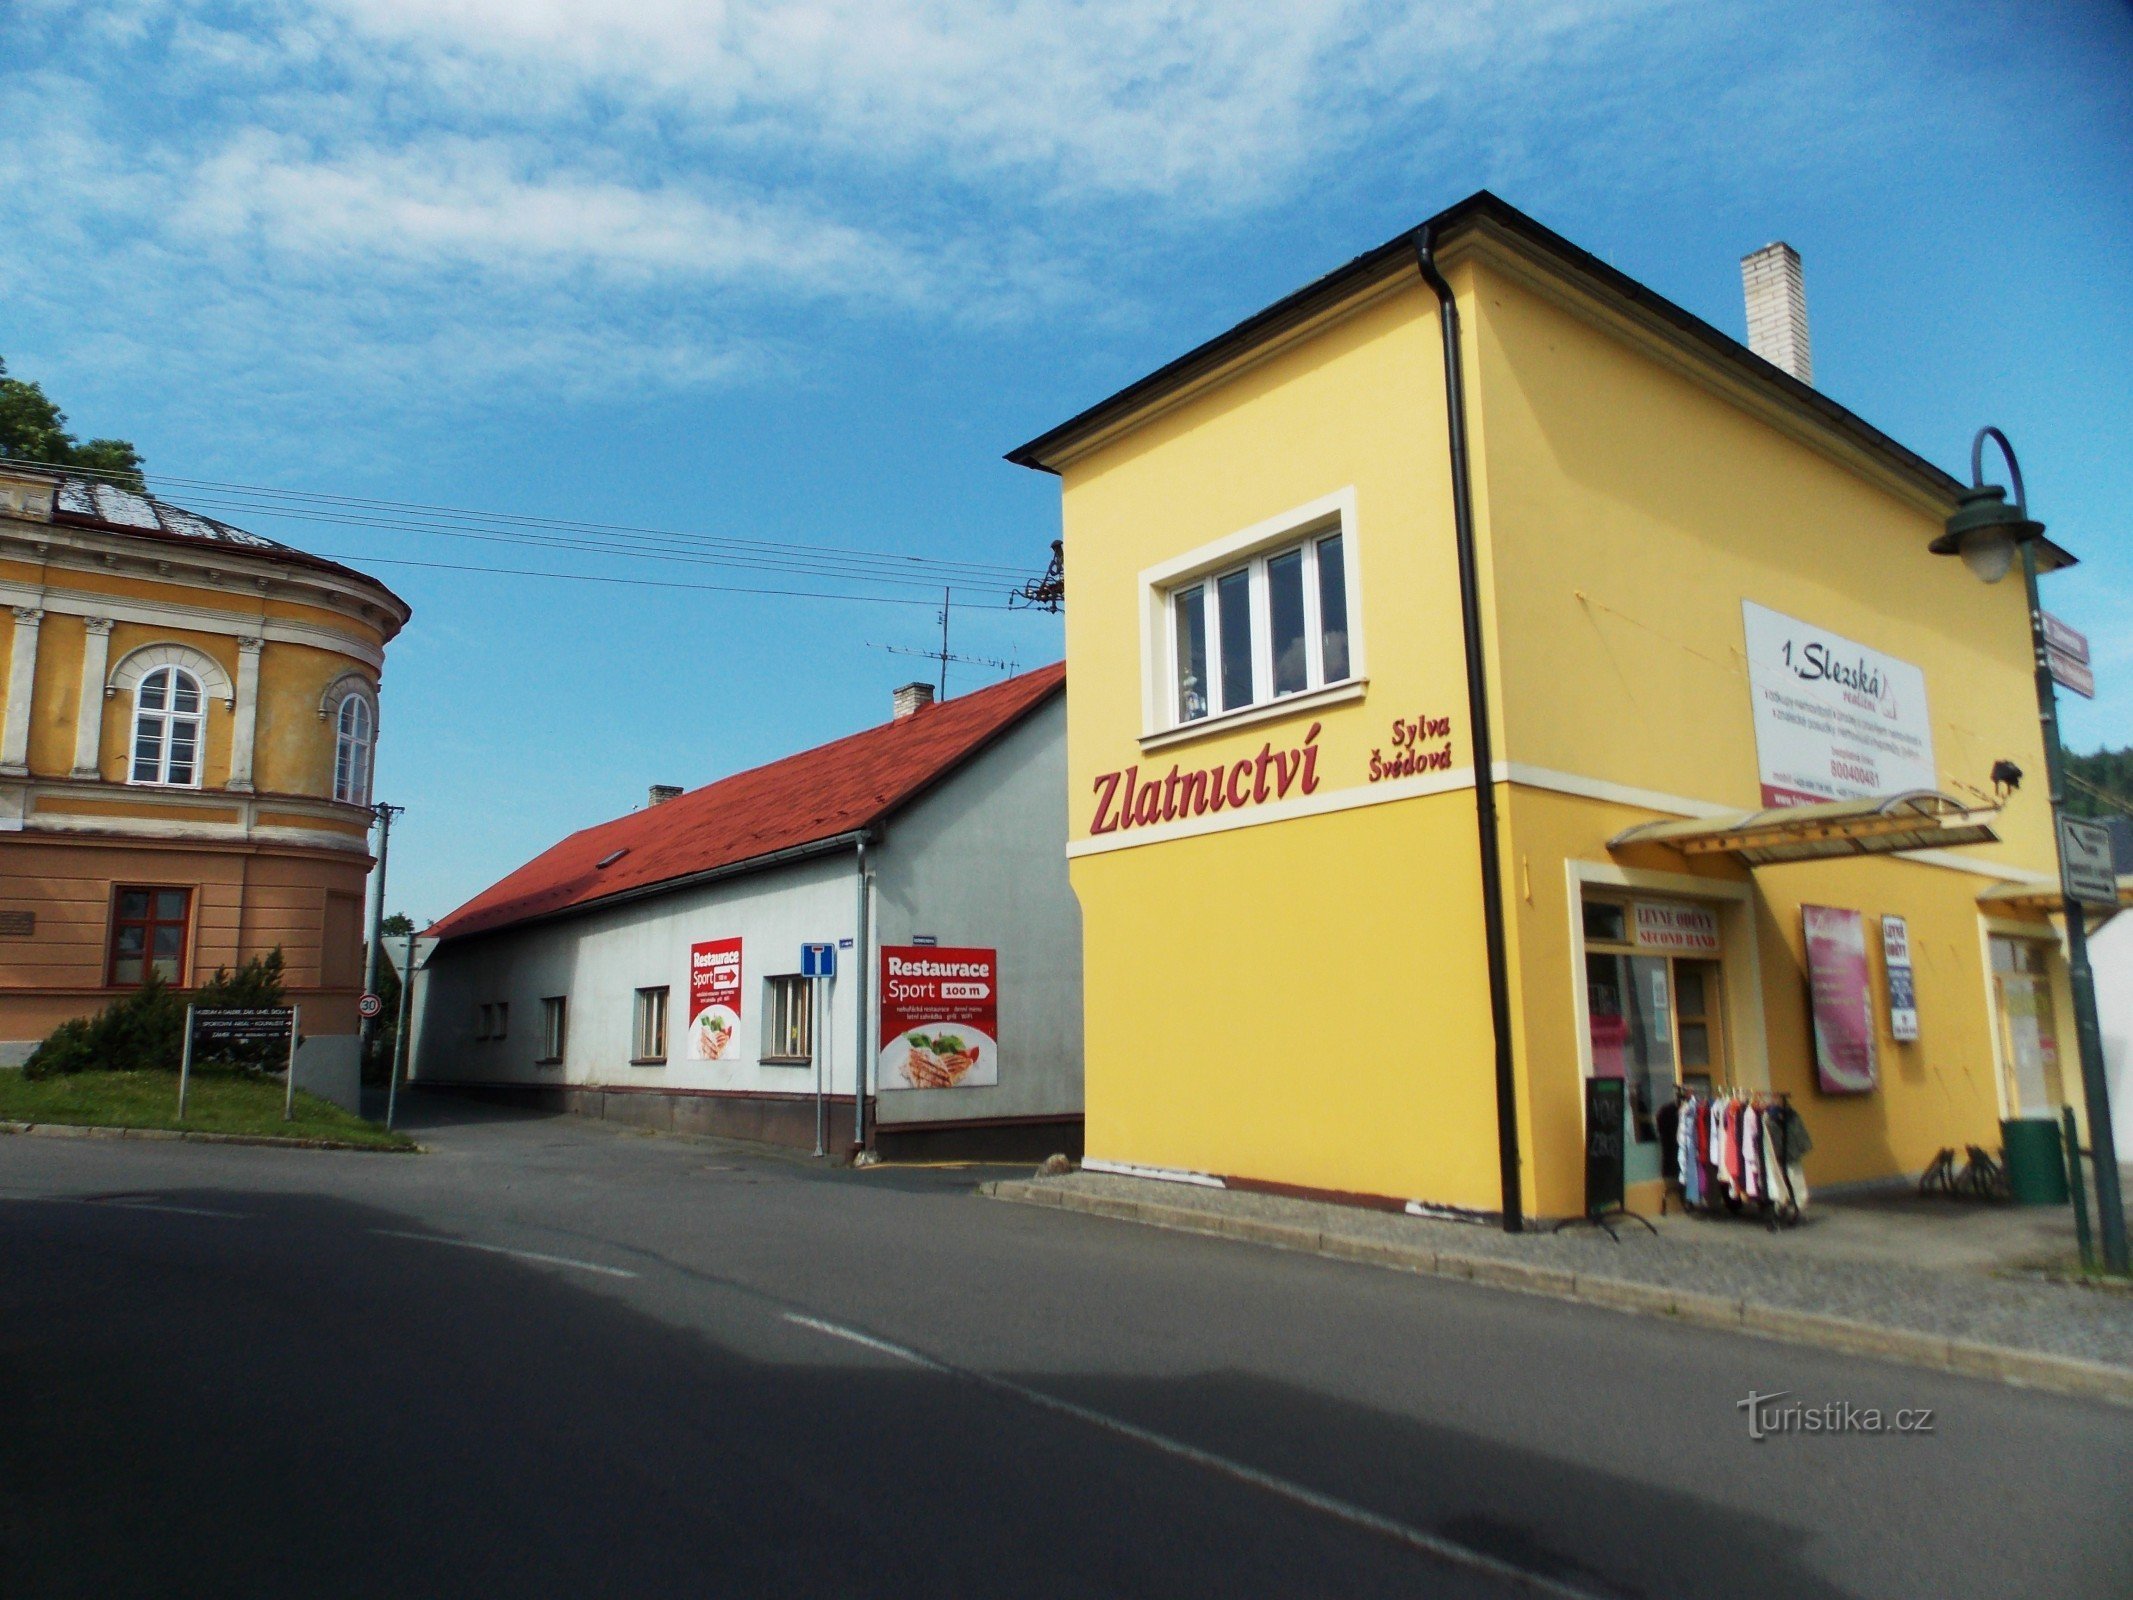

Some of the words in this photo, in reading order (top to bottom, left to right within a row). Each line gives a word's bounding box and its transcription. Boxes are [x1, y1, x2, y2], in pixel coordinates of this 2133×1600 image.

[1392, 714, 1450, 749] Sylva
[1369, 742, 1452, 782] Švédová
[1090, 722, 1321, 835] Zlatnictví
[693, 950, 739, 968] Restaurace
[888, 957, 989, 977] Restaurace
[693, 970, 713, 988] Sport
[889, 980, 935, 1001] Sport
[946, 987, 966, 995] 100
[969, 987, 980, 995] m
[362, 1000, 376, 1010] 30
